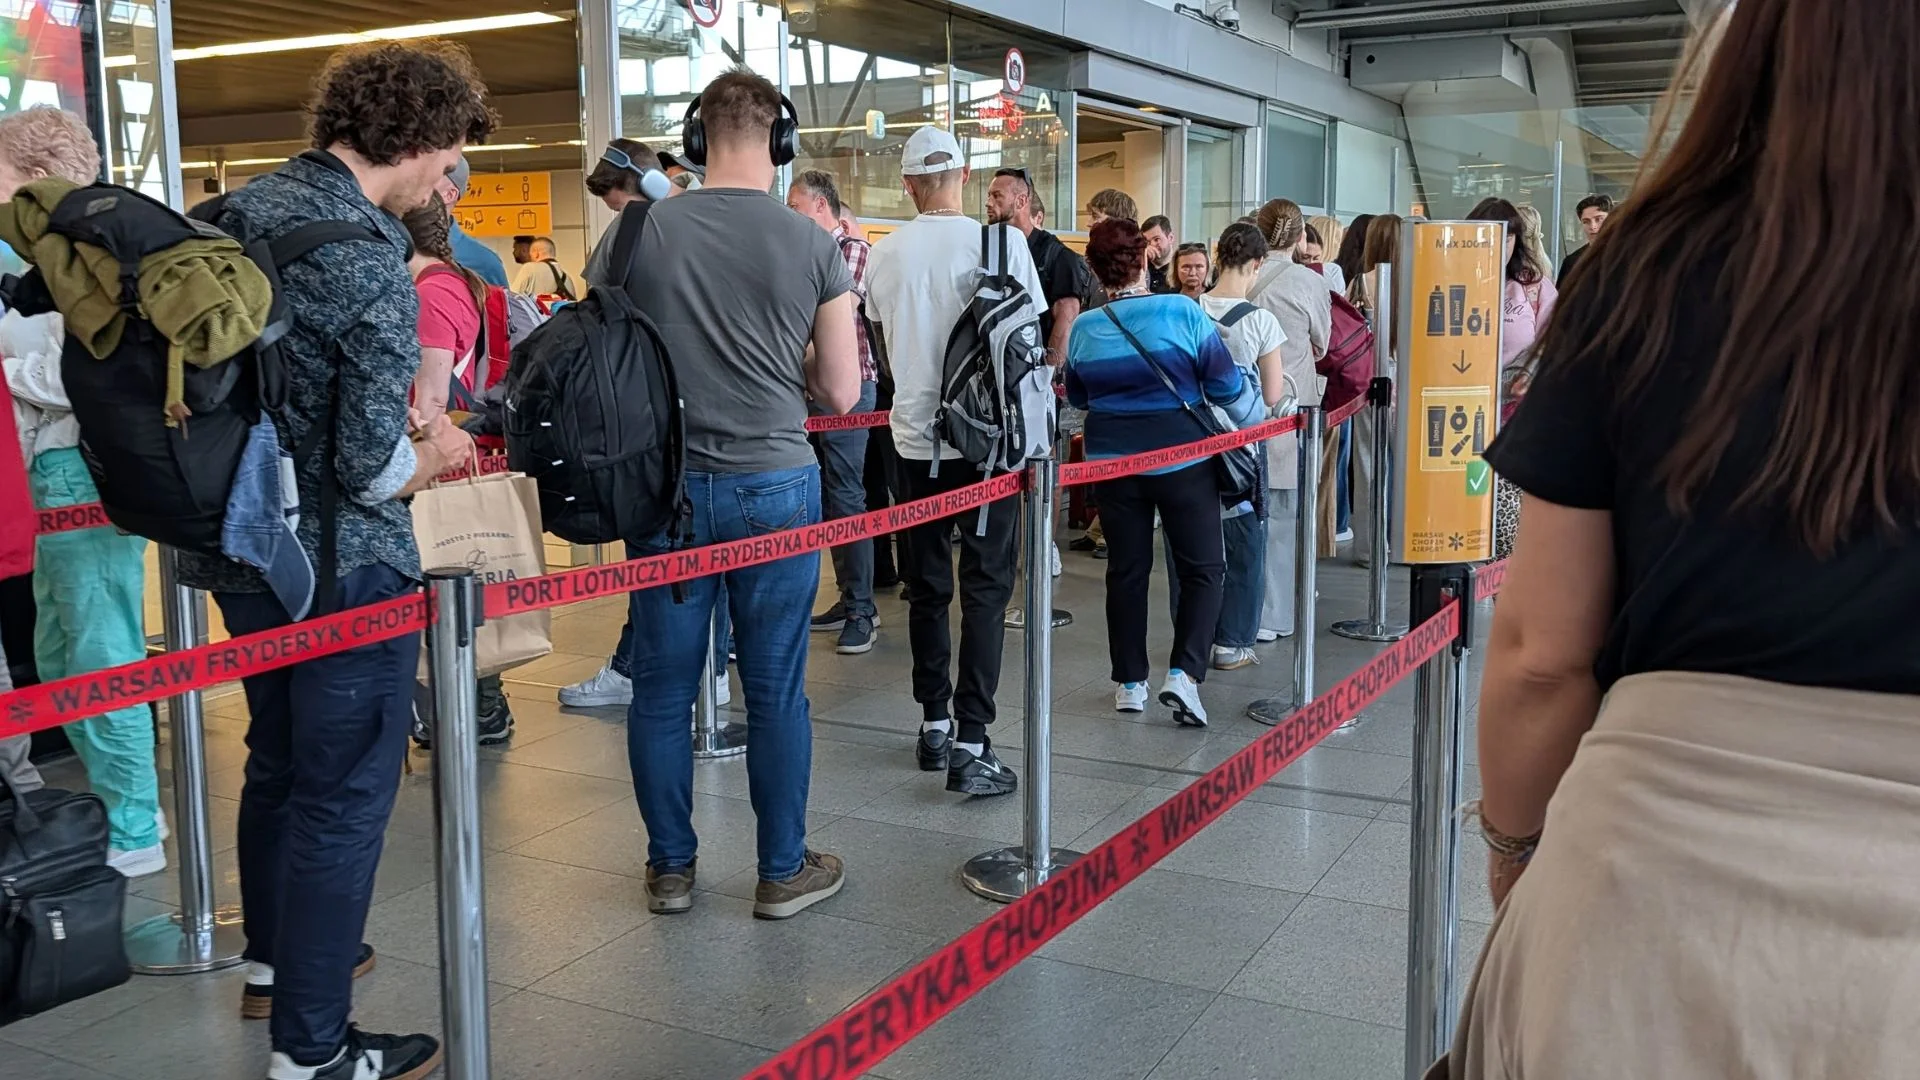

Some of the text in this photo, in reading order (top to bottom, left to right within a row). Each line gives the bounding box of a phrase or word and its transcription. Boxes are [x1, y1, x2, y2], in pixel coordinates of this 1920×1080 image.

[811, 415, 859, 430] FRYDERYKA
[1064, 467, 1083, 480] PORT
[1085, 462, 1118, 478] LOTNICZY
[1133, 452, 1169, 471] FRYDERYKA
[1170, 446, 1196, 461] CHOPINA
[507, 576, 567, 609] PORT
[572, 558, 671, 597] LOTNICZY
[677, 555, 704, 576] IM.
[710, 533, 801, 570] FRYDERYKA
[806, 517, 868, 548] CHOPINA
[888, 498, 942, 528] WARSAW
[944, 481, 996, 510] FREDERIC
[51, 656, 195, 714] WARSAW
[207, 622, 343, 676] FRYDERYK
[754, 608, 1454, 1080] YDERYKA CHOPINA WARSAW FREDERIC CHOPIN AIRPORT
